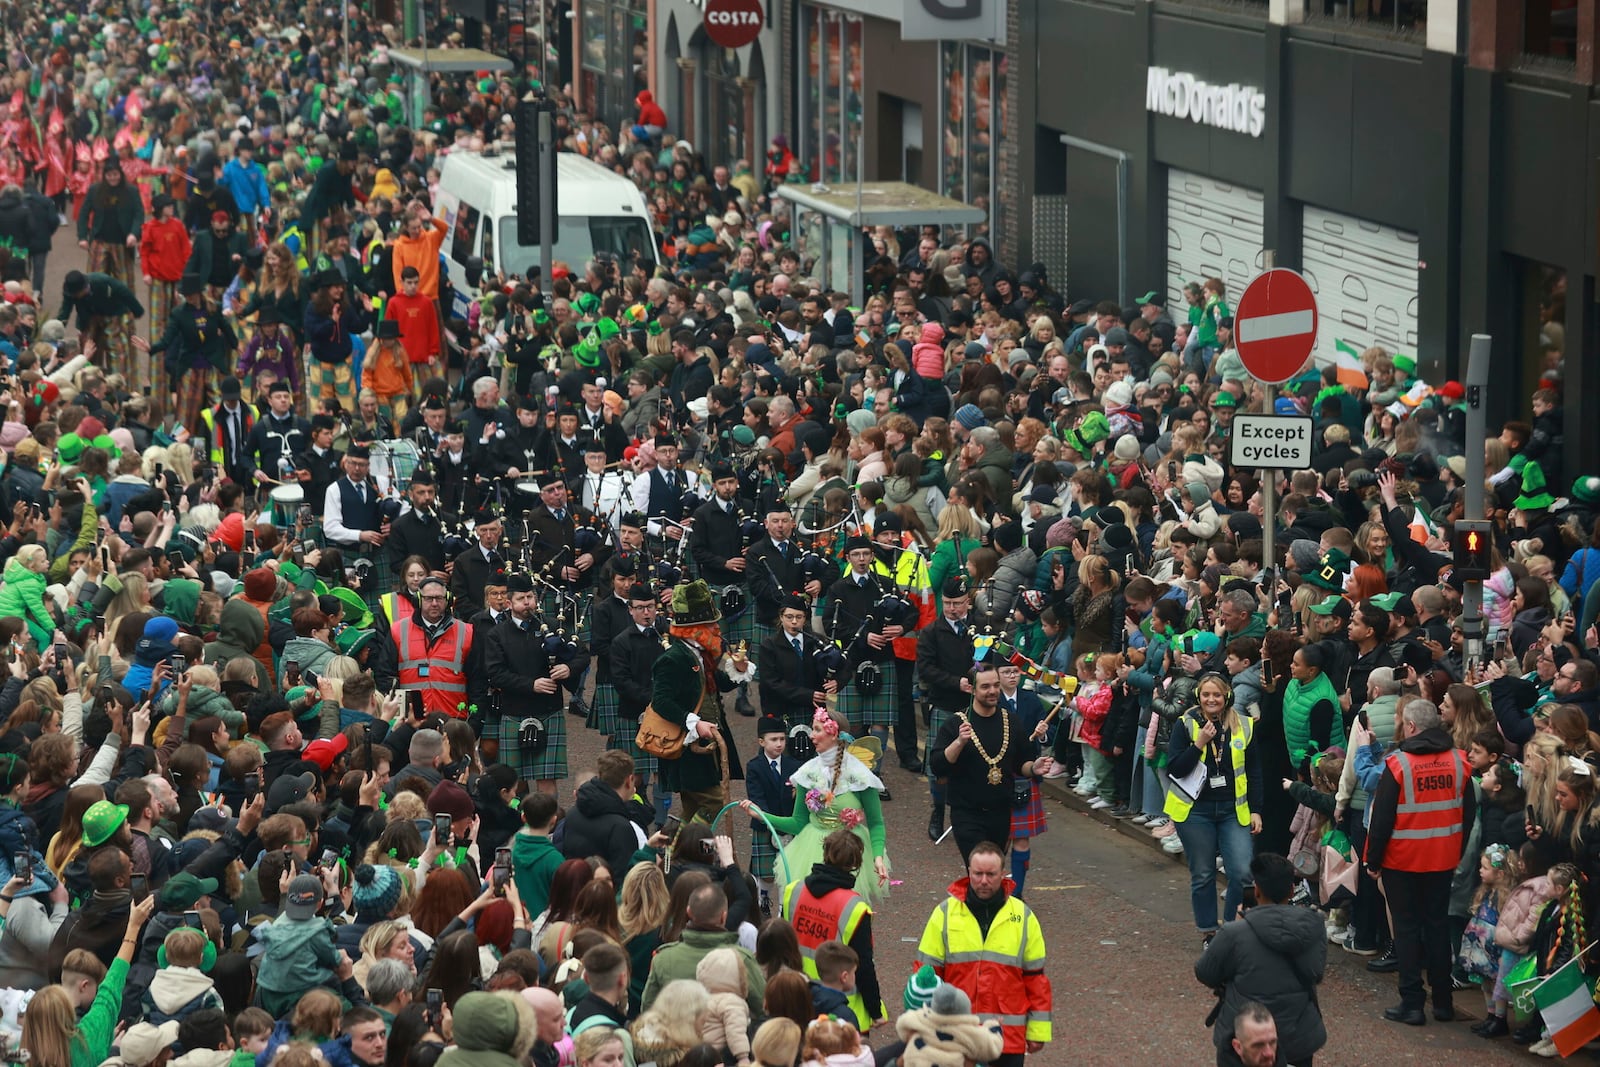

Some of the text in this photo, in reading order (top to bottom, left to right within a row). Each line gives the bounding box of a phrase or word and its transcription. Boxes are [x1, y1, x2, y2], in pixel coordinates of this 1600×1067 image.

[708, 11, 760, 25] COSTA
[1146, 66, 1265, 137] McDonald's
[1241, 423, 1304, 442] Except
[1243, 444, 1300, 460] cycles
[1414, 760, 1451, 770] eventsec
[1417, 774, 1453, 792] E4590
[799, 904, 836, 920] eventsec
[796, 917, 829, 940] E5494
